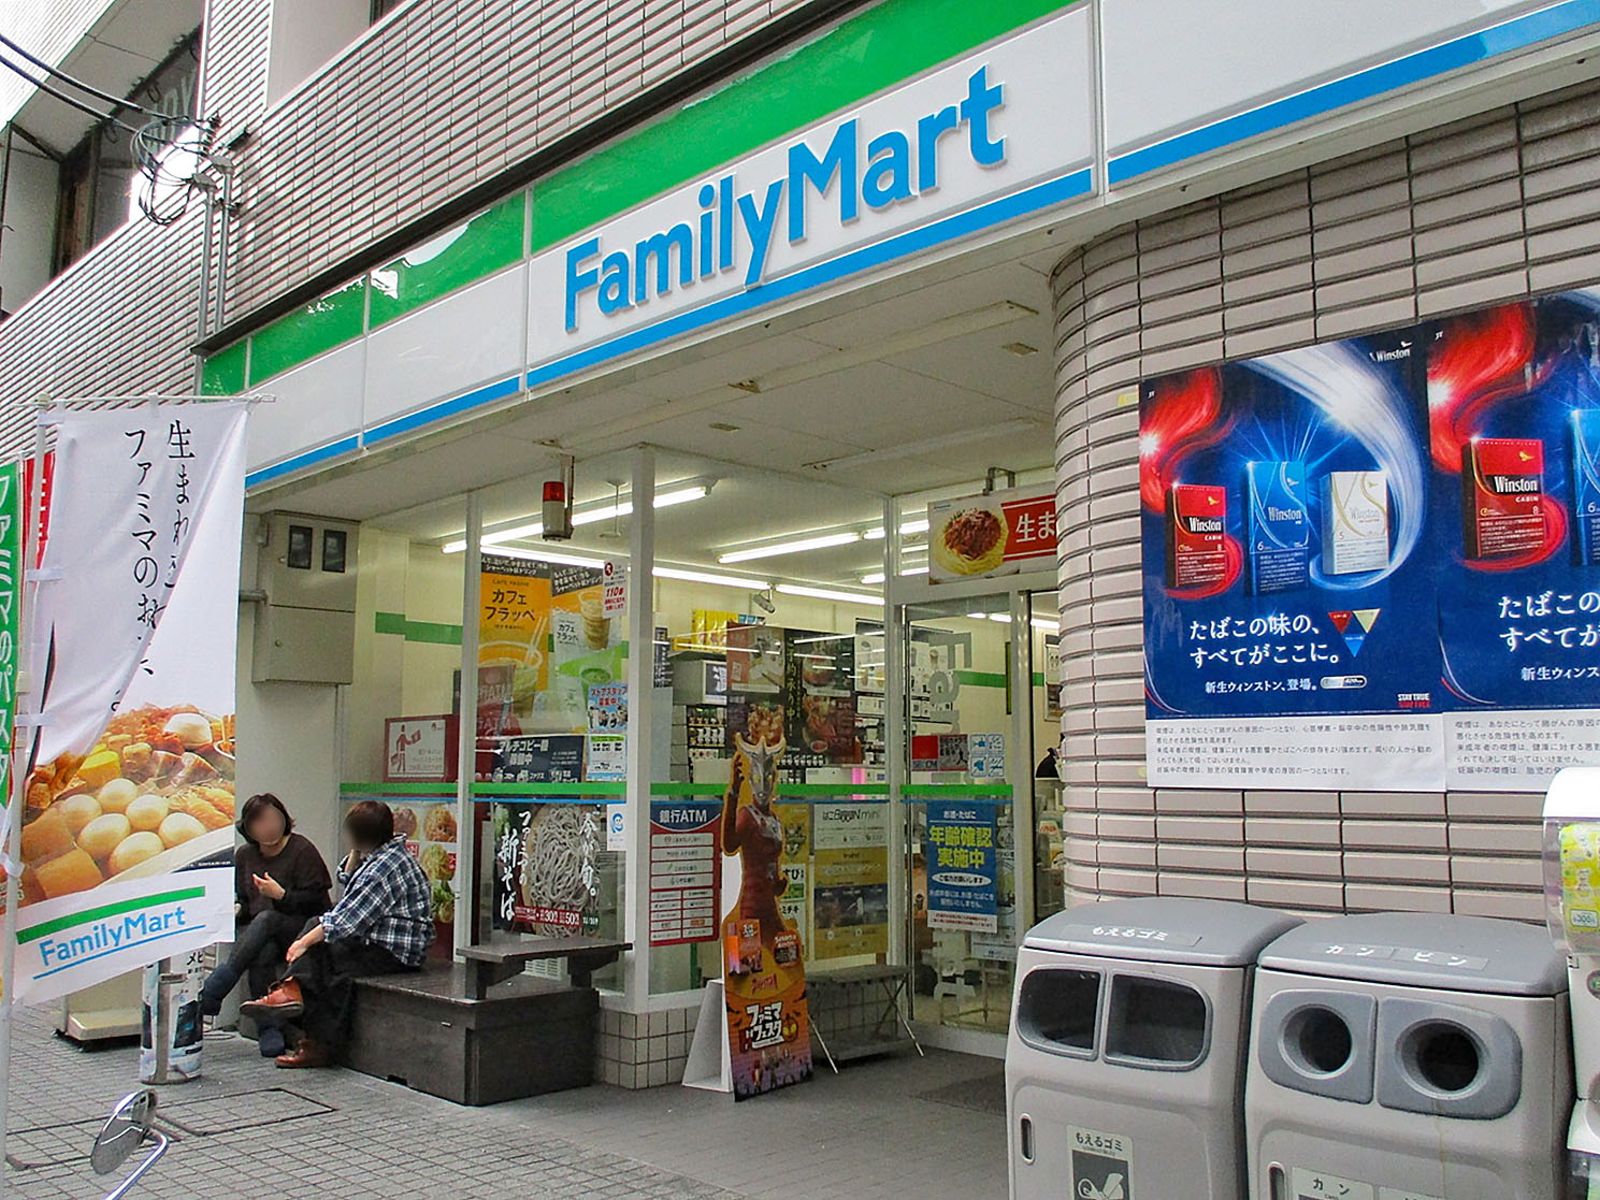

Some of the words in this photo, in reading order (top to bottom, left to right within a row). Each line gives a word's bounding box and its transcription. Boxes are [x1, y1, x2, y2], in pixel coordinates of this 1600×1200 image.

[565, 64, 1005, 333] FamilyMart
[1376, 348, 1411, 362] Winston
[1494, 476, 1538, 493] Winston
[1268, 507, 1302, 522] Winston
[1587, 502, 1596, 513] 6
[1189, 517, 1222, 533] Winston
[1257, 541, 1264, 550] 6
[492, 588, 527, 605] カフェ
[1498, 591, 1600, 618] たばこの
[484, 606, 536, 622] フラッペ
[1190, 613, 1320, 641] たばこの味の、
[1499, 624, 1600, 652] すべてが
[1190, 643, 1339, 669] すべてがここに。
[1205, 677, 1317, 694] 新生ウィンストン、登場。
[659, 809, 707, 824] 銀行ATM
[929, 825, 993, 848] 年齢確認
[937, 848, 985, 869] 実施中
[498, 828, 517, 922] 新そば
[39, 907, 186, 966] FamilyMart
[1092, 926, 1168, 941] もえるゴミ
[1325, 944, 1374, 956] カン
[1412, 951, 1467, 966] ビン
[746, 1001, 782, 1027] ファミマ
[752, 1020, 782, 1041] フェスタ
[1075, 1132, 1123, 1151] もえるゴミ
[1312, 1178, 1350, 1195] カン
